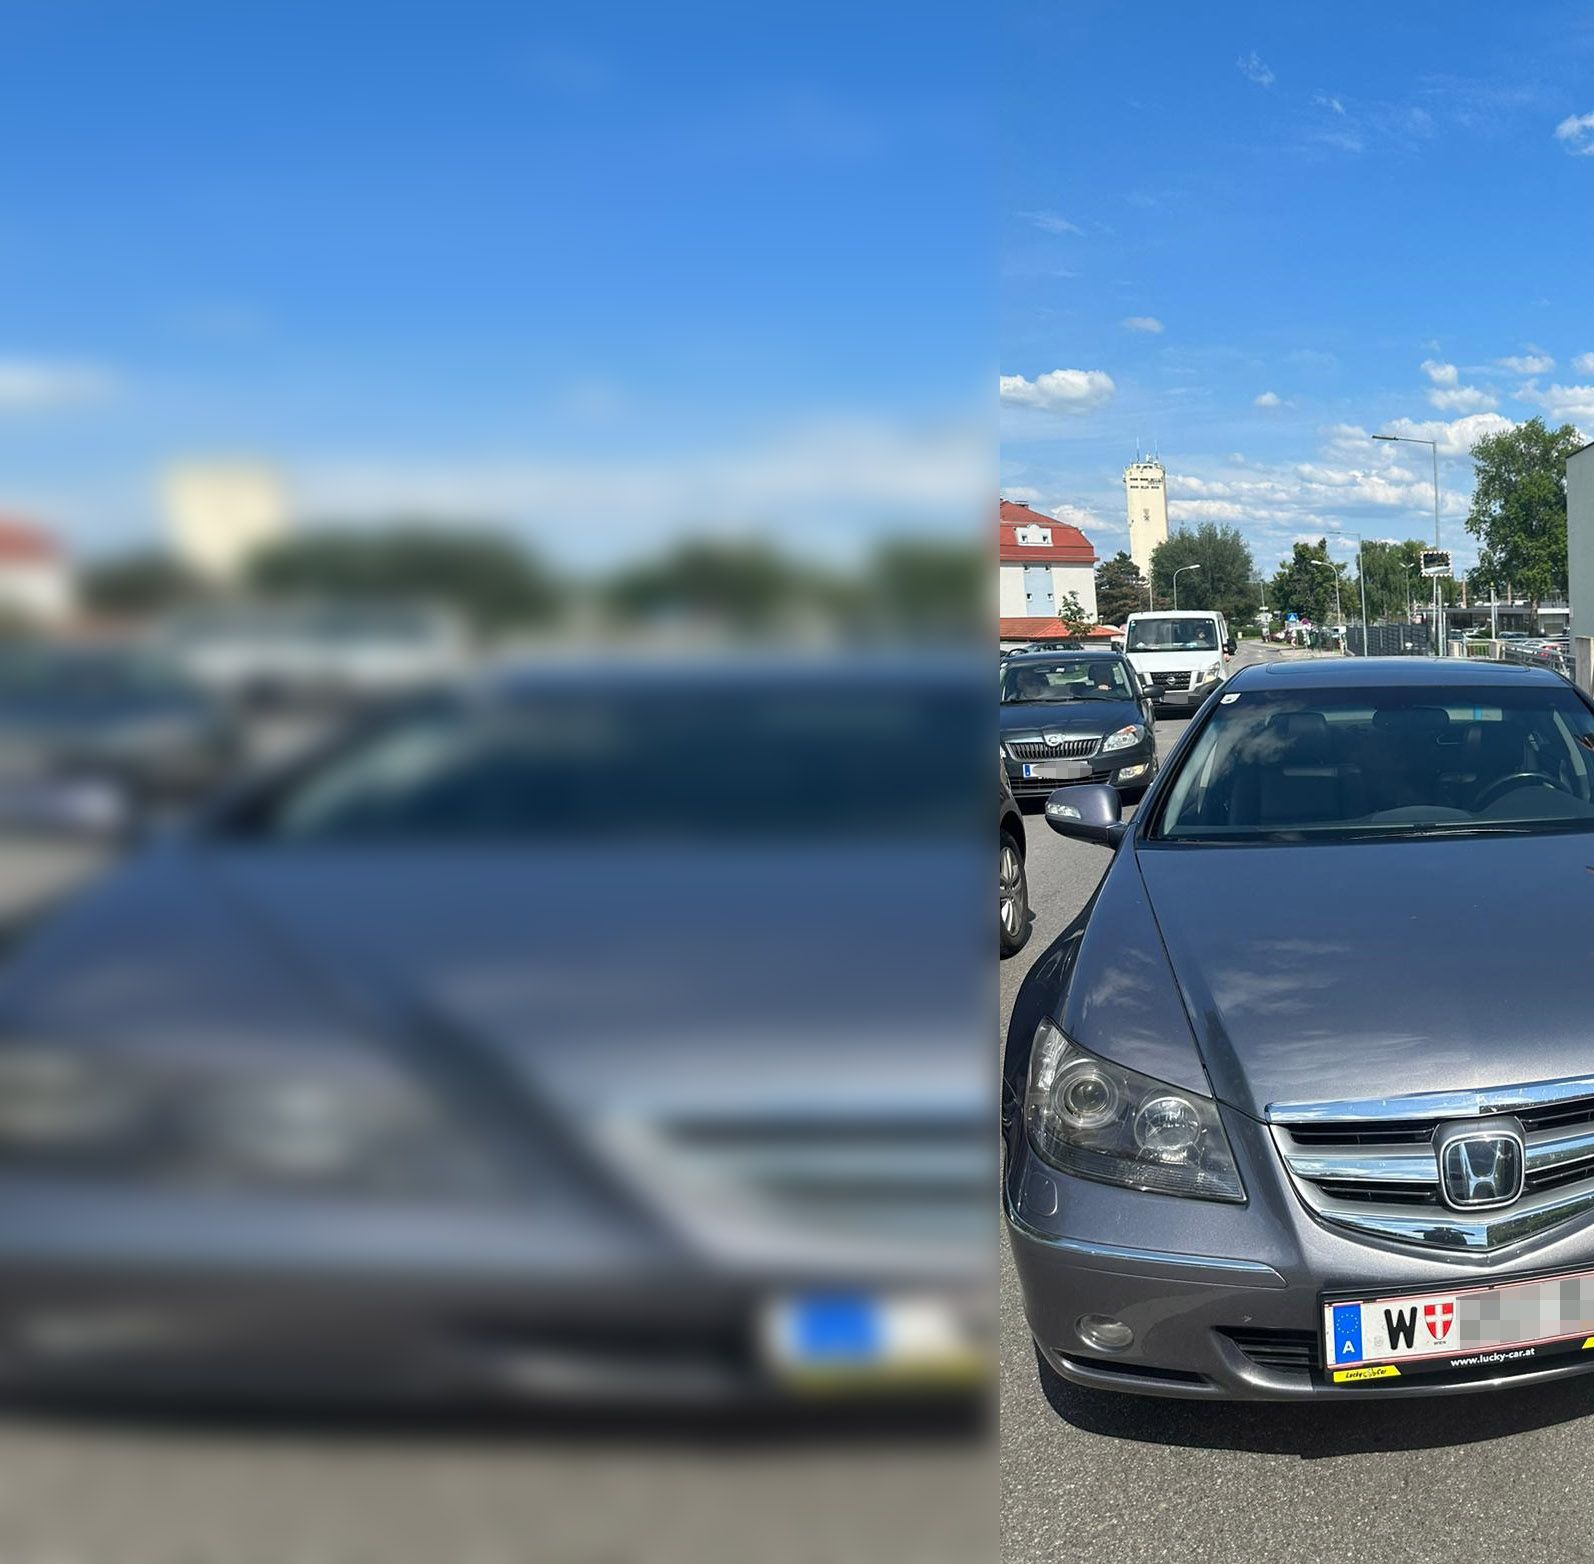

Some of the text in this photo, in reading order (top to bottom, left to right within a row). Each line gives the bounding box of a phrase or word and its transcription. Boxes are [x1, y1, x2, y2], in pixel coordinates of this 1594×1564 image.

[1384, 1306, 1418, 1351] W
[1342, 1340, 1356, 1354] A
[1450, 1347, 1536, 1368] www.lucky-car.at
[1345, 1371, 1363, 1379] Lucky
